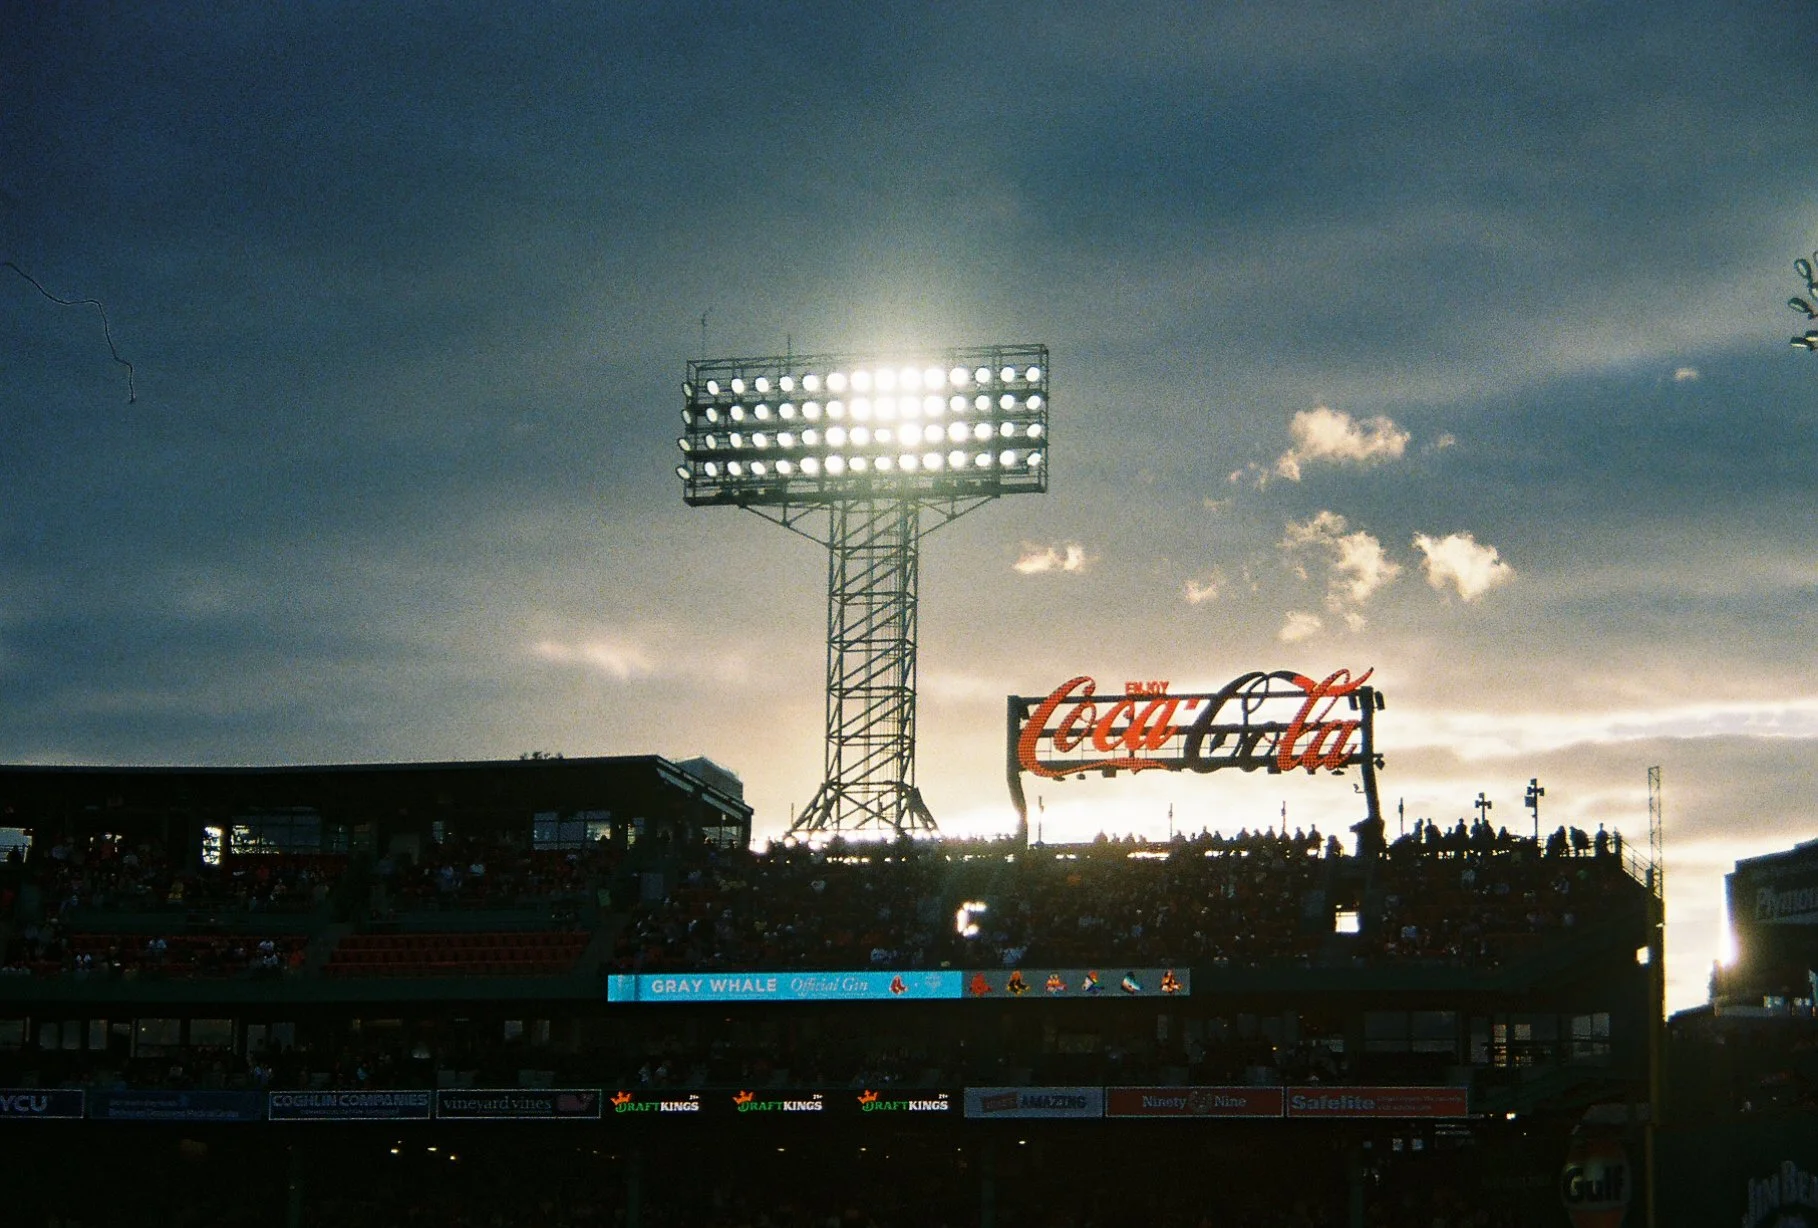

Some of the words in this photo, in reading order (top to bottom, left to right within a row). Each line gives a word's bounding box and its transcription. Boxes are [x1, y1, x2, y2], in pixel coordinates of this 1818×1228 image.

[1125, 681, 1169, 695] ENJOY
[1018, 668, 1374, 778] Coca-Cola
[652, 980, 702, 993] GRAY
[710, 978, 777, 992] WHALE
[790, 977, 839, 995] Official
[842, 978, 869, 992] Gin
[272, 1095, 337, 1107] COGHLIN
[339, 1094, 428, 1106] COMPANIES
[615, 1101, 699, 1113] DRAFTKINGS
[737, 1101, 822, 1112] DRAFTKINGS
[862, 1101, 948, 1112] DRAFTKINGS
[1142, 1095, 1187, 1110] Ninety
[1214, 1095, 1248, 1108] Nine
[1291, 1094, 1376, 1110] Safelite
[1563, 1166, 1622, 1202] Gulf
